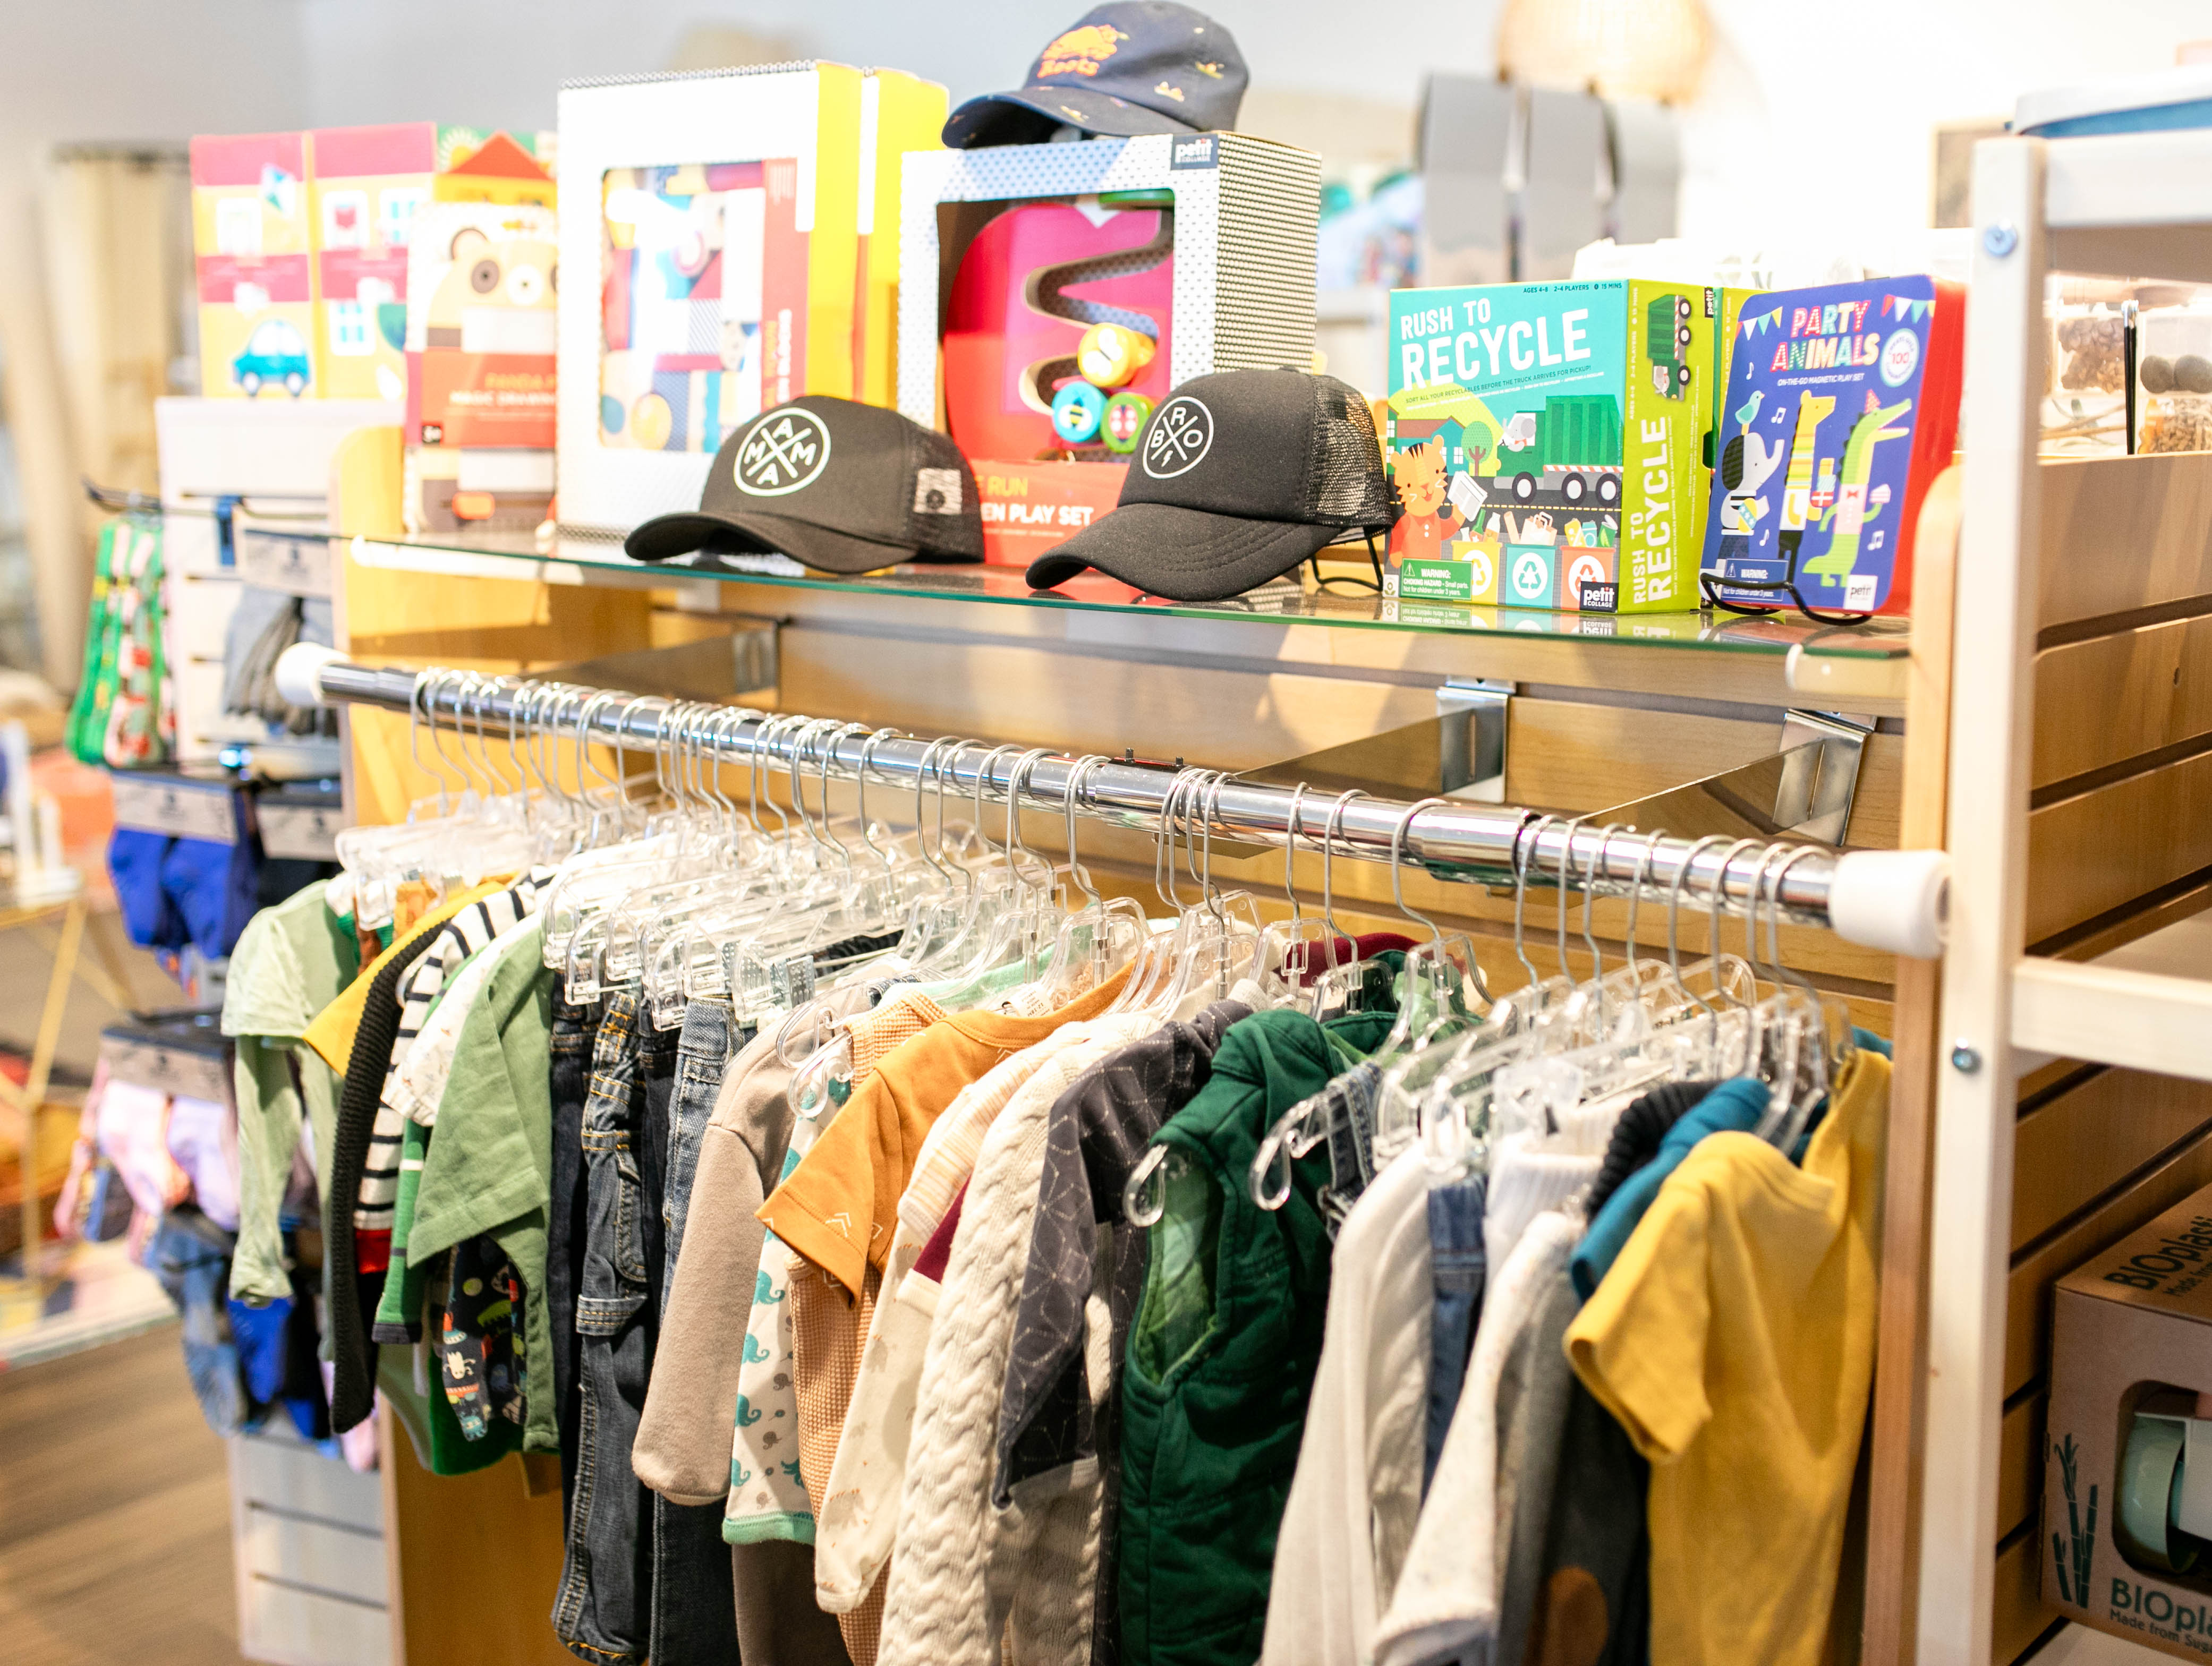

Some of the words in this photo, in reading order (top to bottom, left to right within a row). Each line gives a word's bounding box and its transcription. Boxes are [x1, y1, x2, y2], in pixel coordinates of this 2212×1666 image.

[1037, 58, 1100, 78] Roots
[1175, 138, 1213, 164] petit
[1705, 290, 1714, 315] petit
[1401, 306, 1453, 340] RUSH
[1464, 298, 1491, 326] TO
[1790, 300, 1871, 338] PARTY
[1402, 308, 1591, 391] RECYCLE
[1769, 332, 1881, 372] ANIMALS
[1892, 352, 1910, 364] 100
[1445, 385, 1480, 397] RECYCLABLES
[1534, 372, 1556, 381] ARRIVES
[1570, 365, 1591, 374] PICKUP!
[1777, 377, 1808, 386] ON-THE-GO
[1808, 375, 1837, 384] MAGNETIC
[1838, 374, 1853, 382] PLAY
[987, 476, 1028, 497] RUN
[1009, 503, 1056, 524] PLAY
[1058, 506, 1094, 526] SET
[1641, 416, 1672, 602] RECYCLE
[1630, 511, 1644, 540] TO
[1421, 568, 1451, 579] WARNING:
[1632, 549, 1646, 604] RUSH
[1584, 586, 1615, 606] petit
[2110, 1609, 2146, 1631] Made
[2149, 1622, 2181, 1643] from
